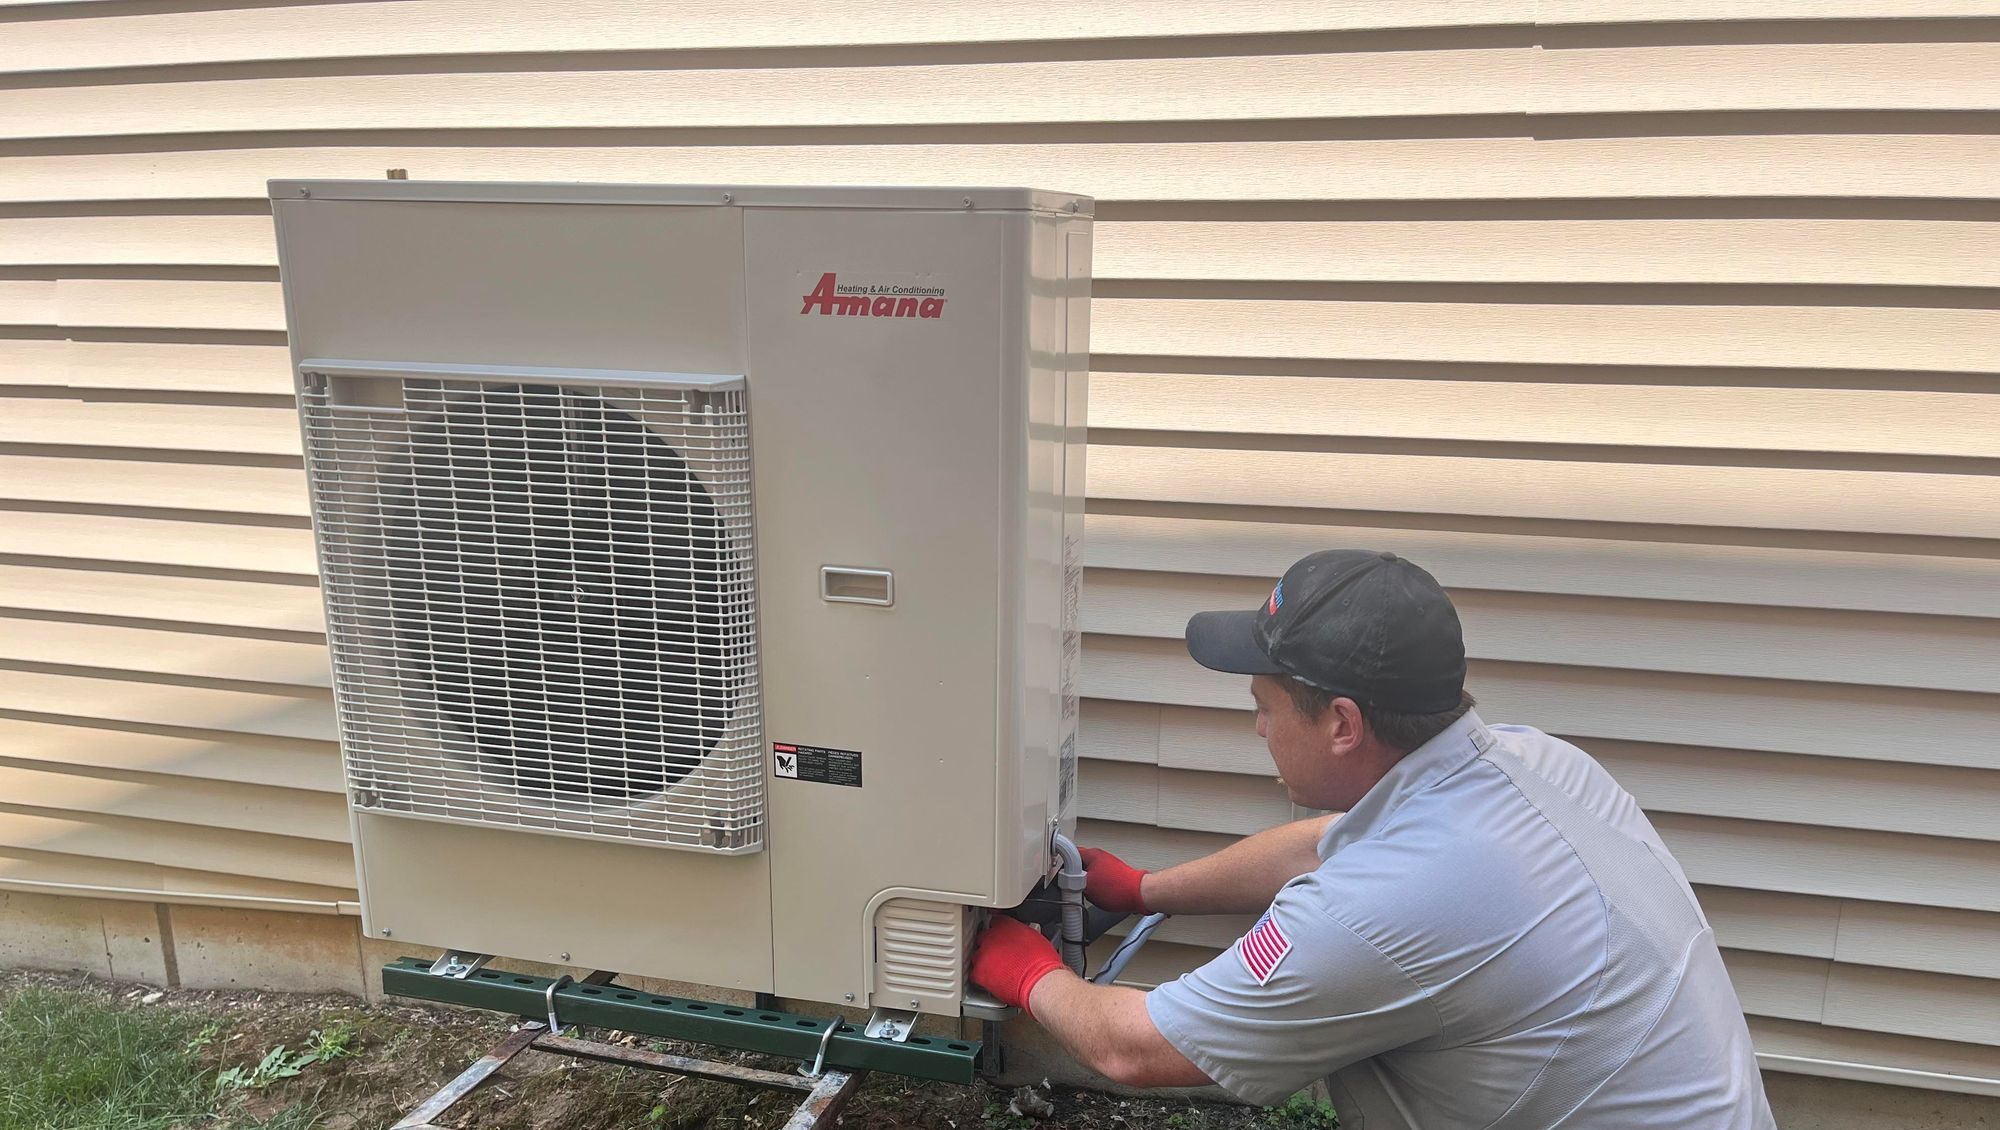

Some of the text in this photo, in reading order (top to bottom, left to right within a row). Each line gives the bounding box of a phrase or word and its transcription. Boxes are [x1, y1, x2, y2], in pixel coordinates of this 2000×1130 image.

[800, 272, 945, 318] Amana
[836, 284, 945, 296] Heating & Air Conditioning
